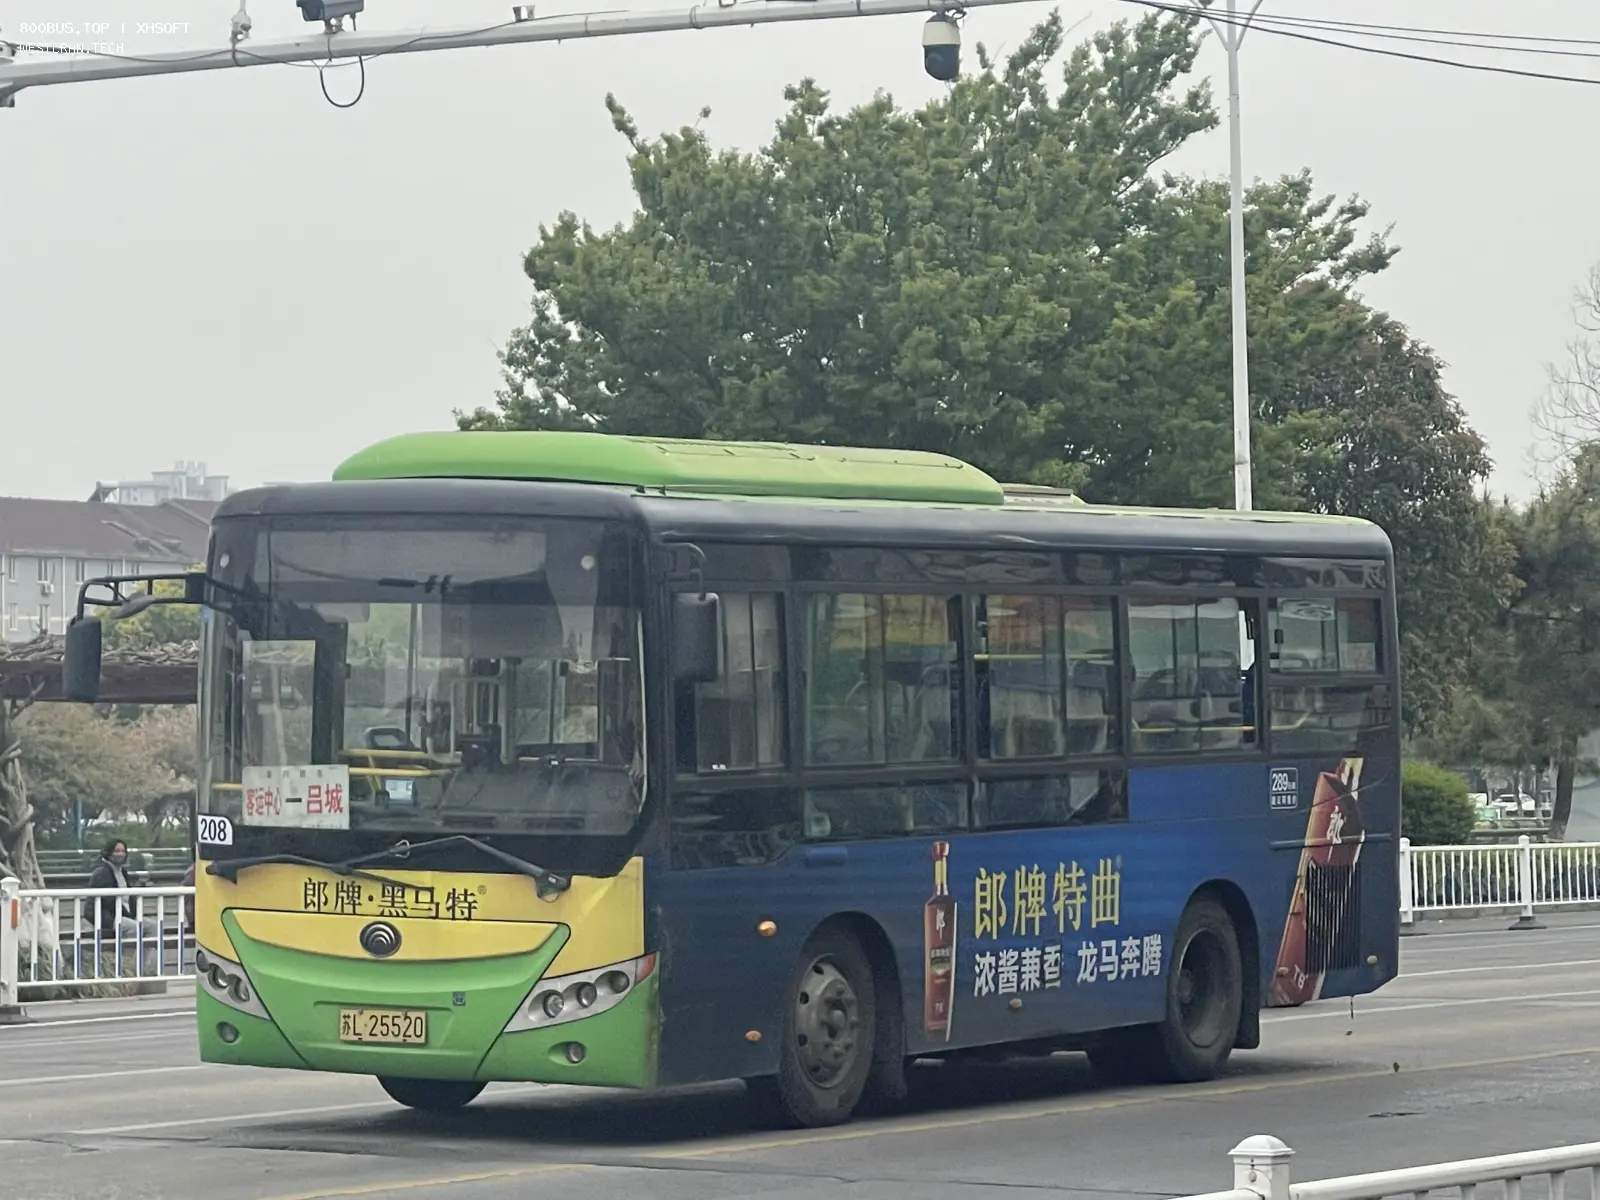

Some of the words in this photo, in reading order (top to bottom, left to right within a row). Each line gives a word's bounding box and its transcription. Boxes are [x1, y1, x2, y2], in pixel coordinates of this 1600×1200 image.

[1272, 772, 1289, 791] 289
[200, 817, 227, 842] 208
[974, 857, 1121, 941] 郎牌特曲
[973, 943, 1065, 998] 浓酱兼香
[1076, 933, 1162, 987] 龙马奔腾
